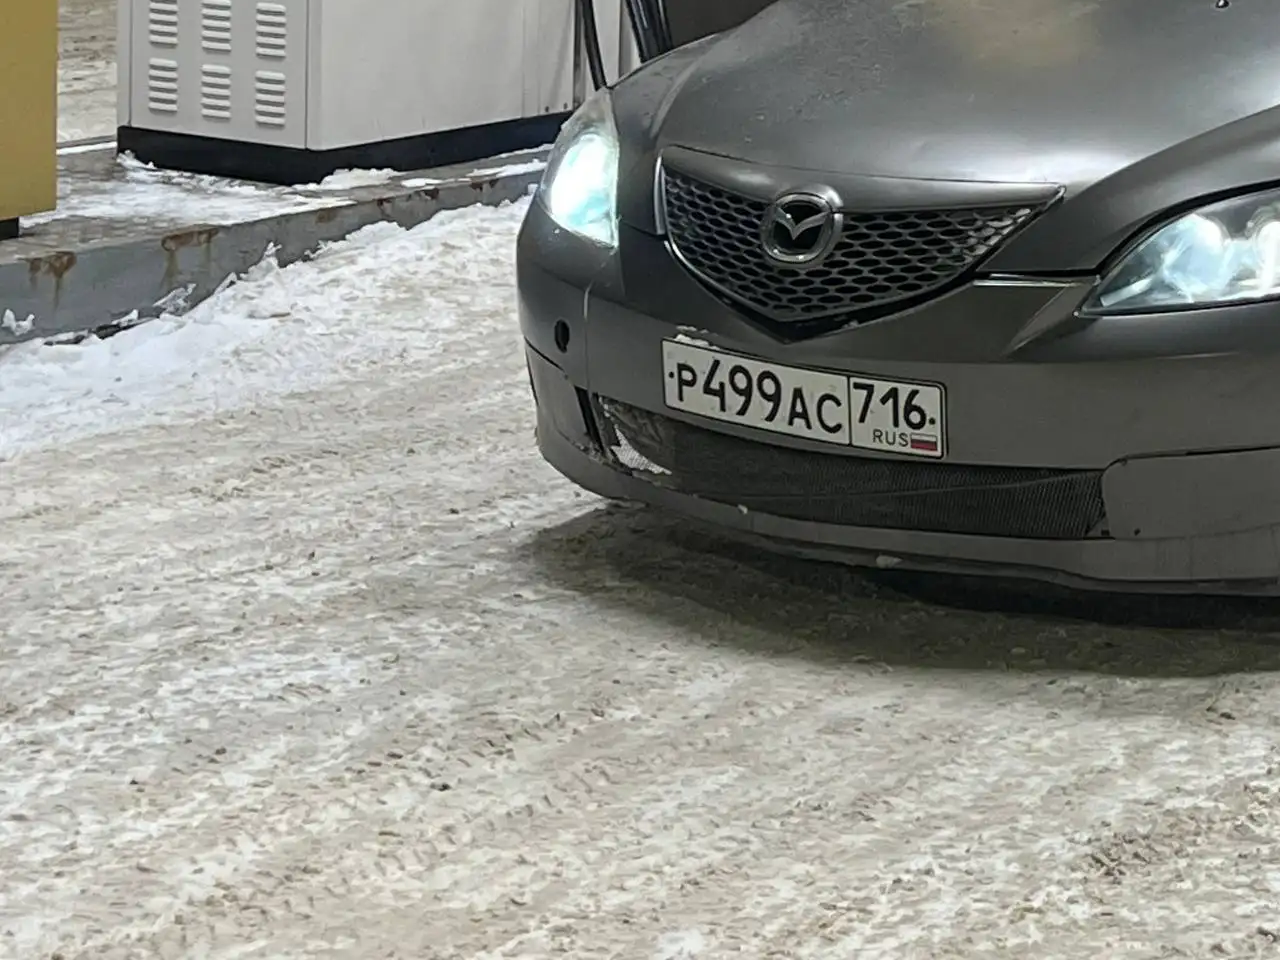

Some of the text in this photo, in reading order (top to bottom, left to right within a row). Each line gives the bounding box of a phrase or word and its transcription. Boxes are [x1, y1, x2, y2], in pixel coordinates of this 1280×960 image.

[676, 359, 927, 434] Р499АС 716
[872, 429, 909, 447] RUS
